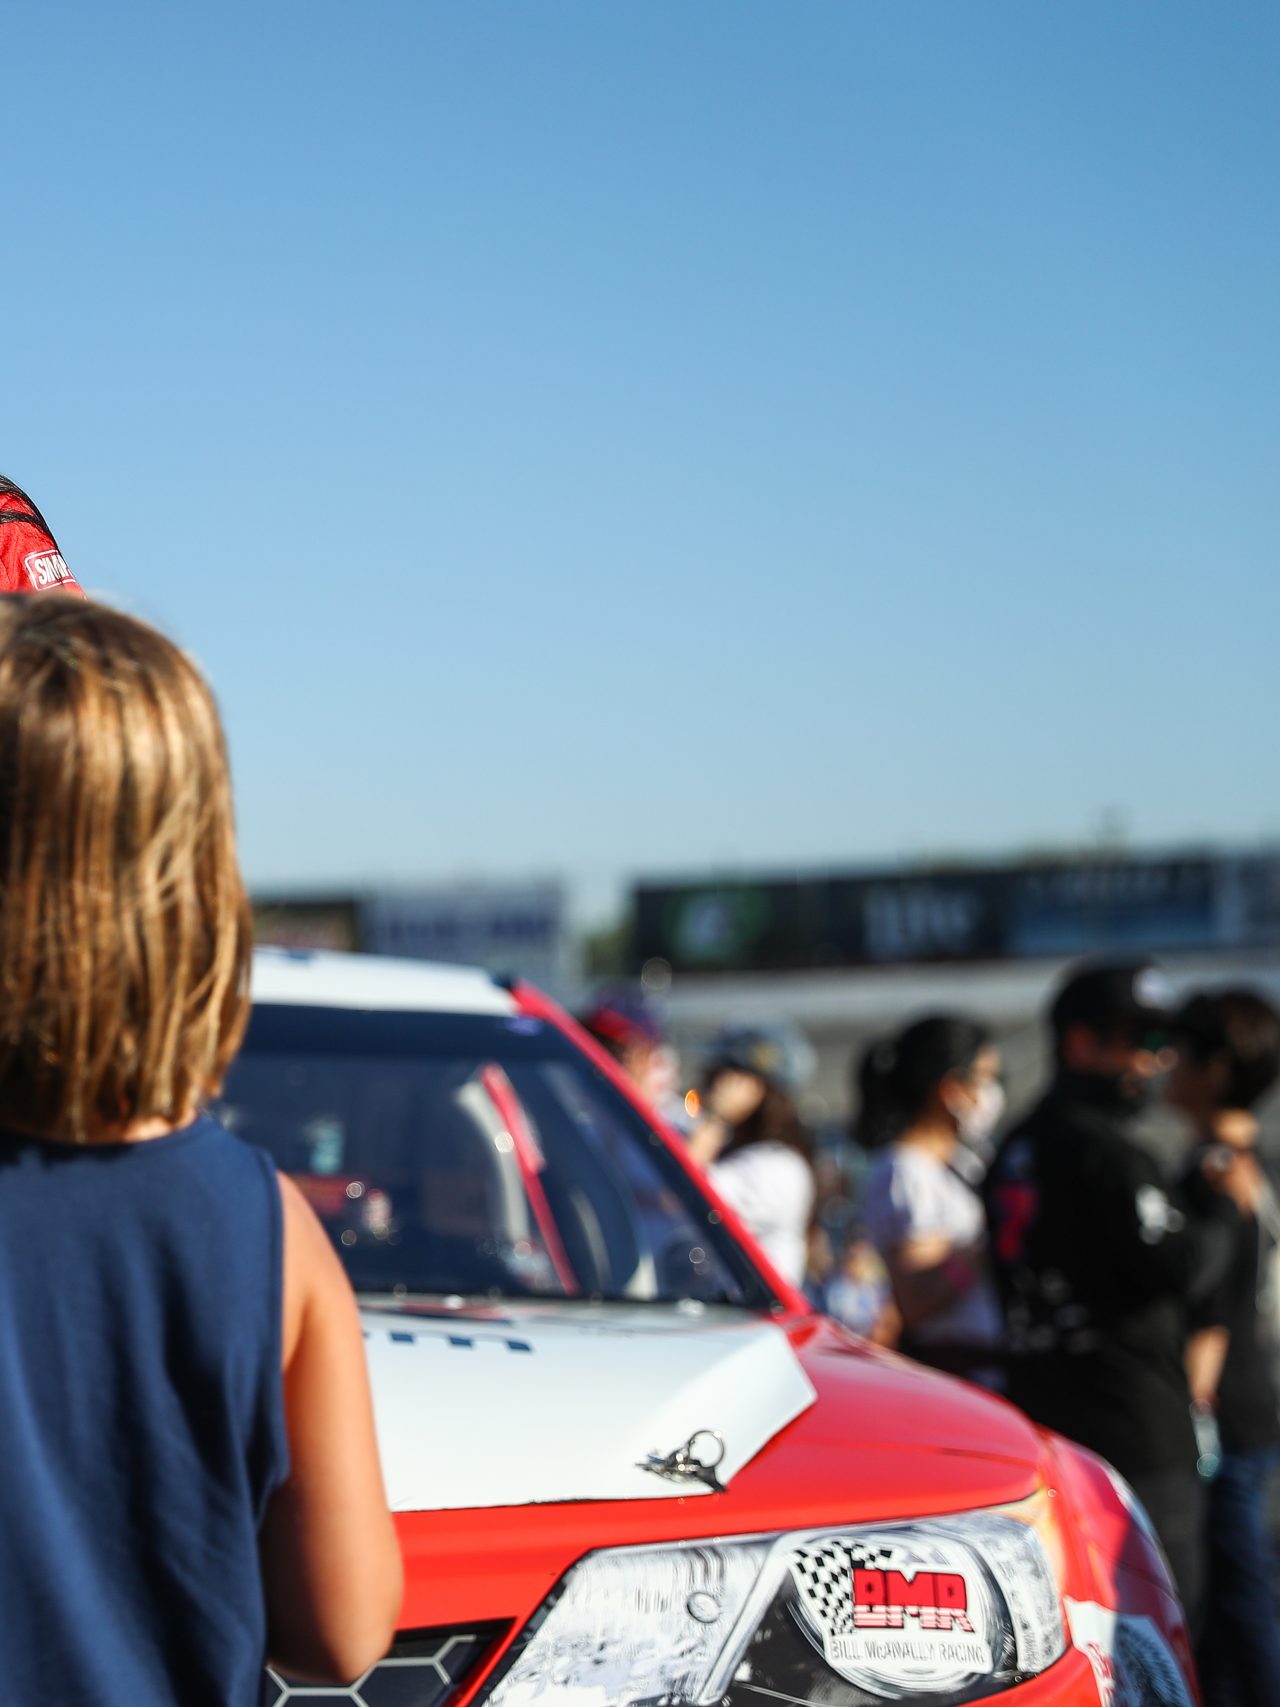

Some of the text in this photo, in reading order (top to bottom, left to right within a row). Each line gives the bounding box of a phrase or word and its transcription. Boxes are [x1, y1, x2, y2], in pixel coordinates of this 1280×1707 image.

[853, 1567, 976, 1633] BMR
[830, 1639, 861, 1660] BILL
[939, 1642, 986, 1665] RACING
